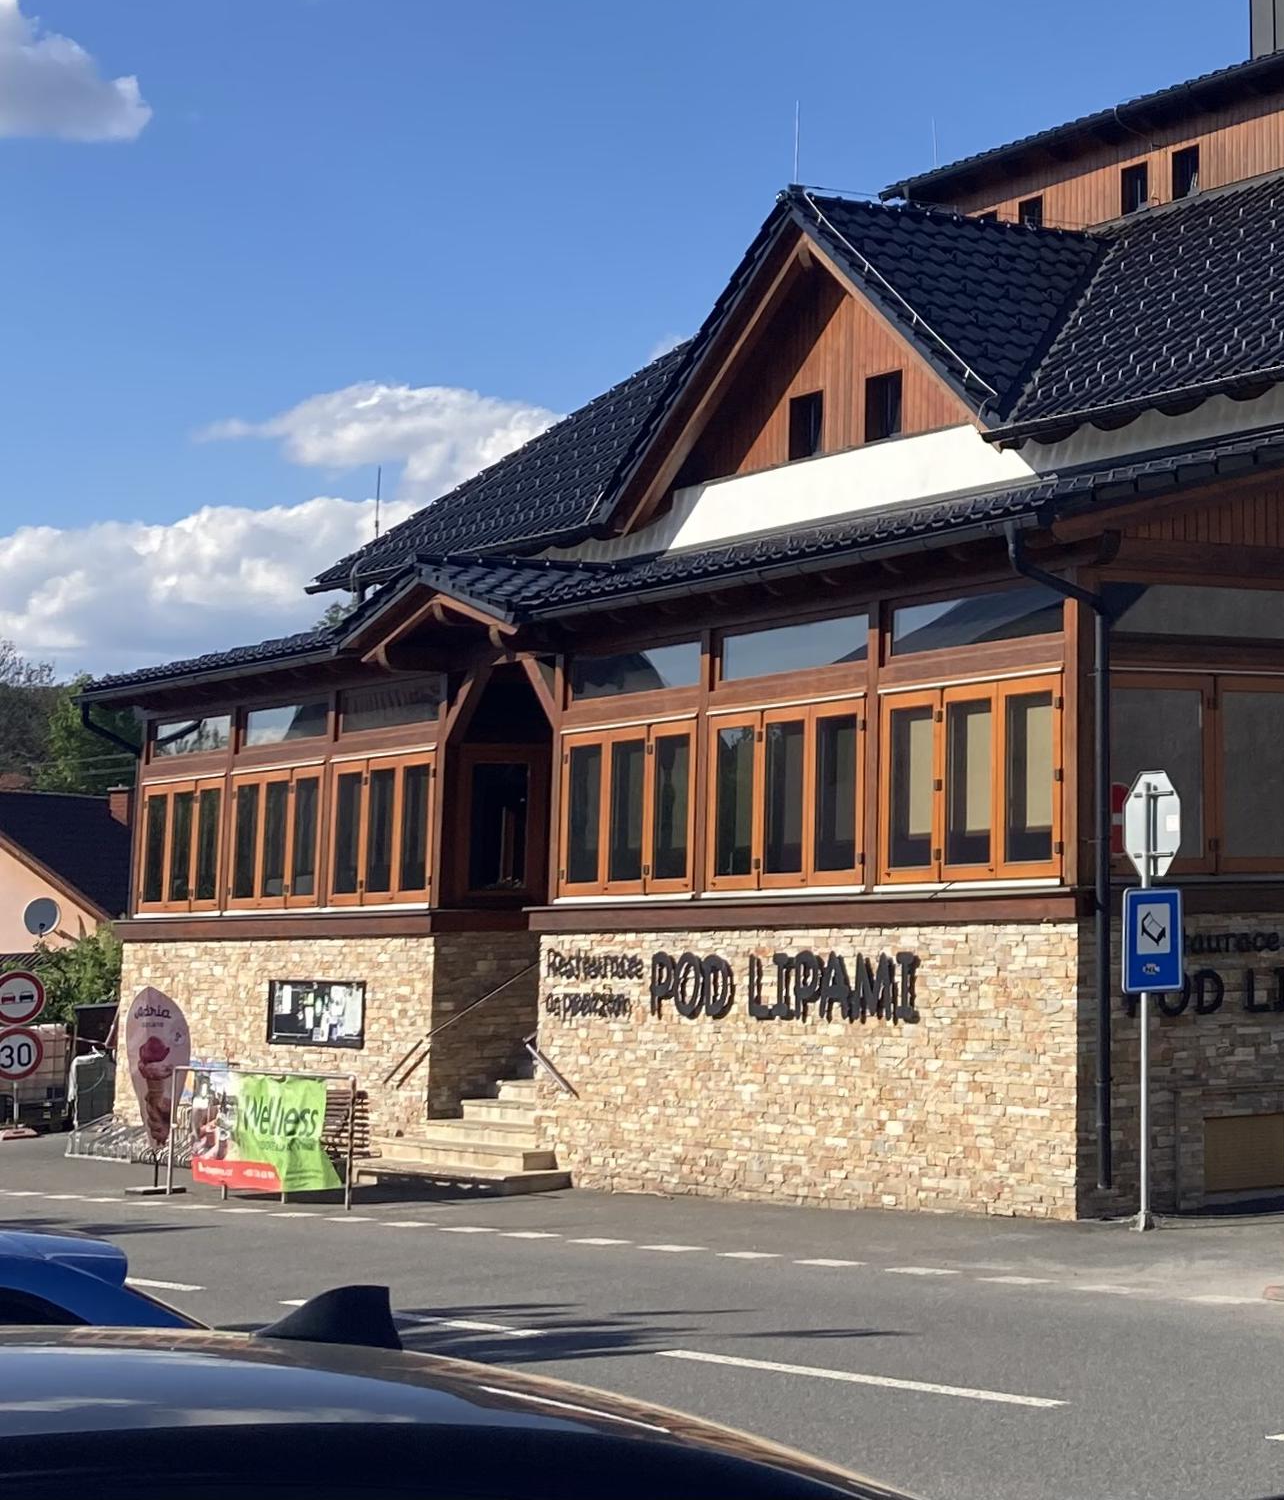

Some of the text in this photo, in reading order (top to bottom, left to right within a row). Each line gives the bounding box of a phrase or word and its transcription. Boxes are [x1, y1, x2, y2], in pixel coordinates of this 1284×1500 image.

[651, 950, 920, 1025] POD LIPAMI
[0, 1043, 32, 1069] 30
[243, 1096, 319, 1137] Wellness
